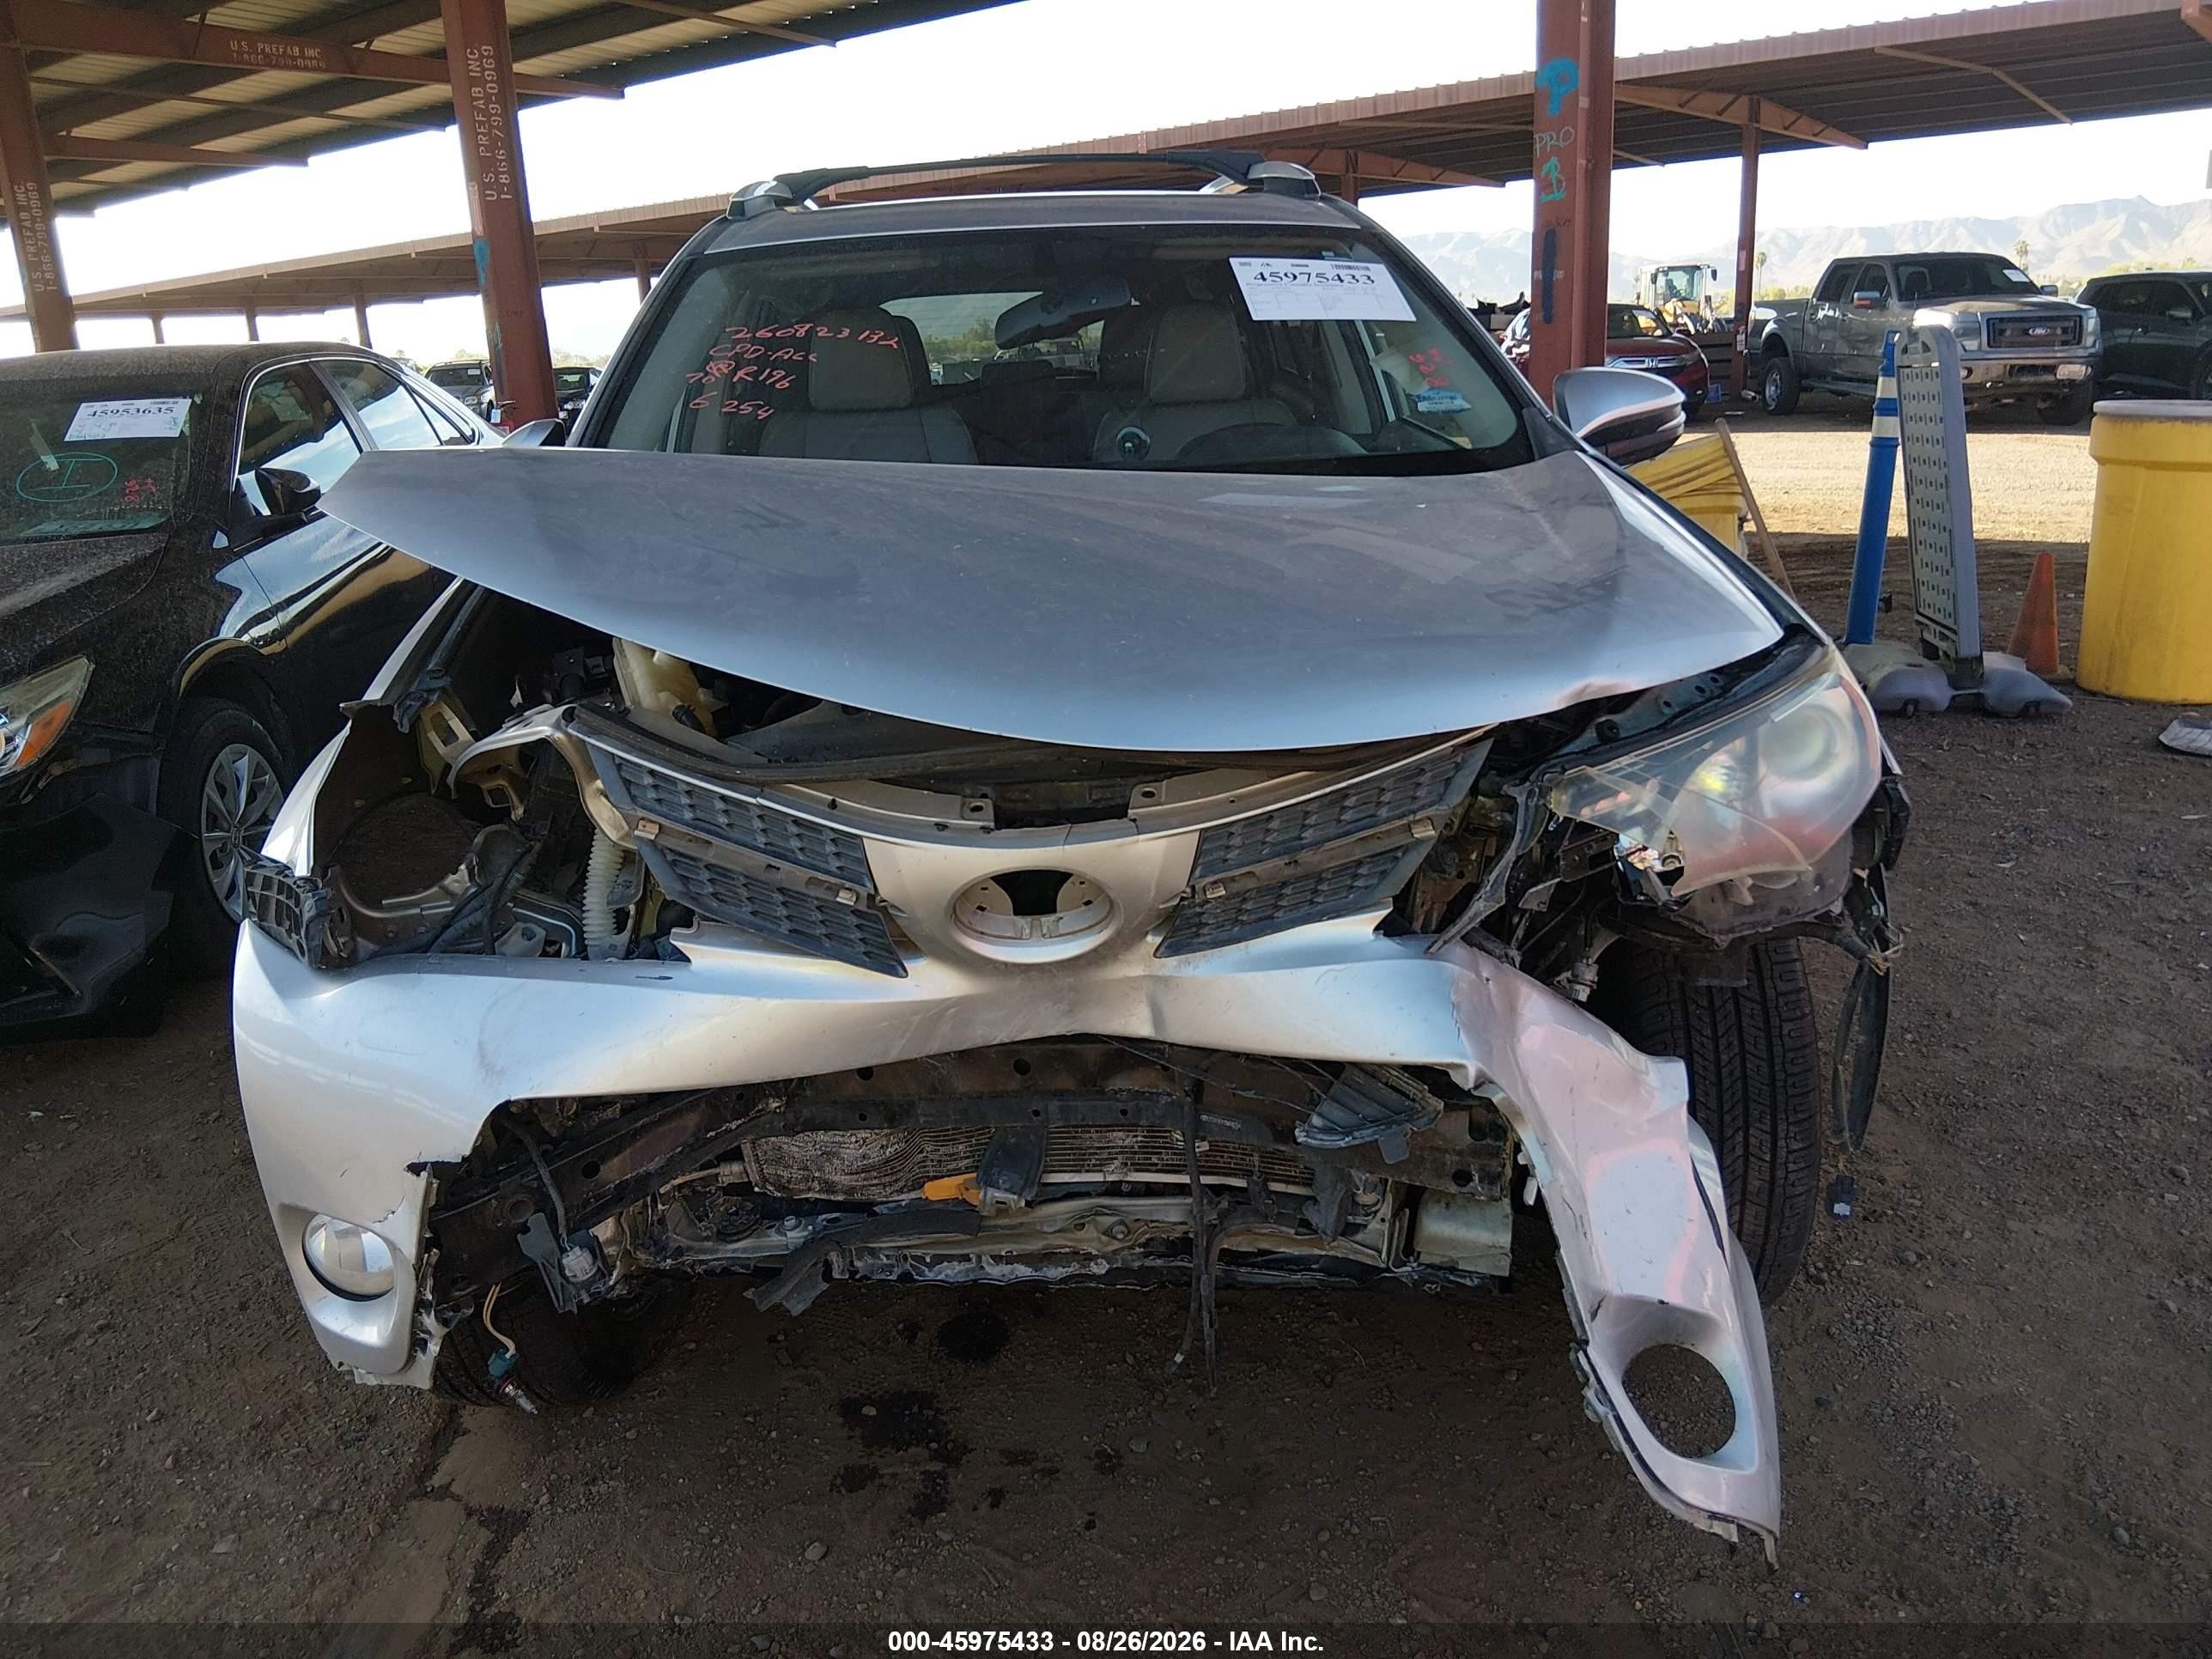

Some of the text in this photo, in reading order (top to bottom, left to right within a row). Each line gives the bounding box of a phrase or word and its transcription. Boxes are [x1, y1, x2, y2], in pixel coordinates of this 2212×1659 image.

[258, 42, 300, 57] PREFAB
[471, 87, 492, 156] PREFAB
[481, 46, 514, 199] 1-866-799-0969
[1534, 125, 1575, 158] PRO
[483, 168, 497, 201] U.S.
[19, 212, 40, 261] PREFAB
[27, 182, 58, 290] 1-866-799-0969
[32, 268, 45, 292] U.S.
[1254, 271, 1375, 285] 45975433
[88, 406, 175, 417] 45953635
[721, 400, 775, 420] 254
